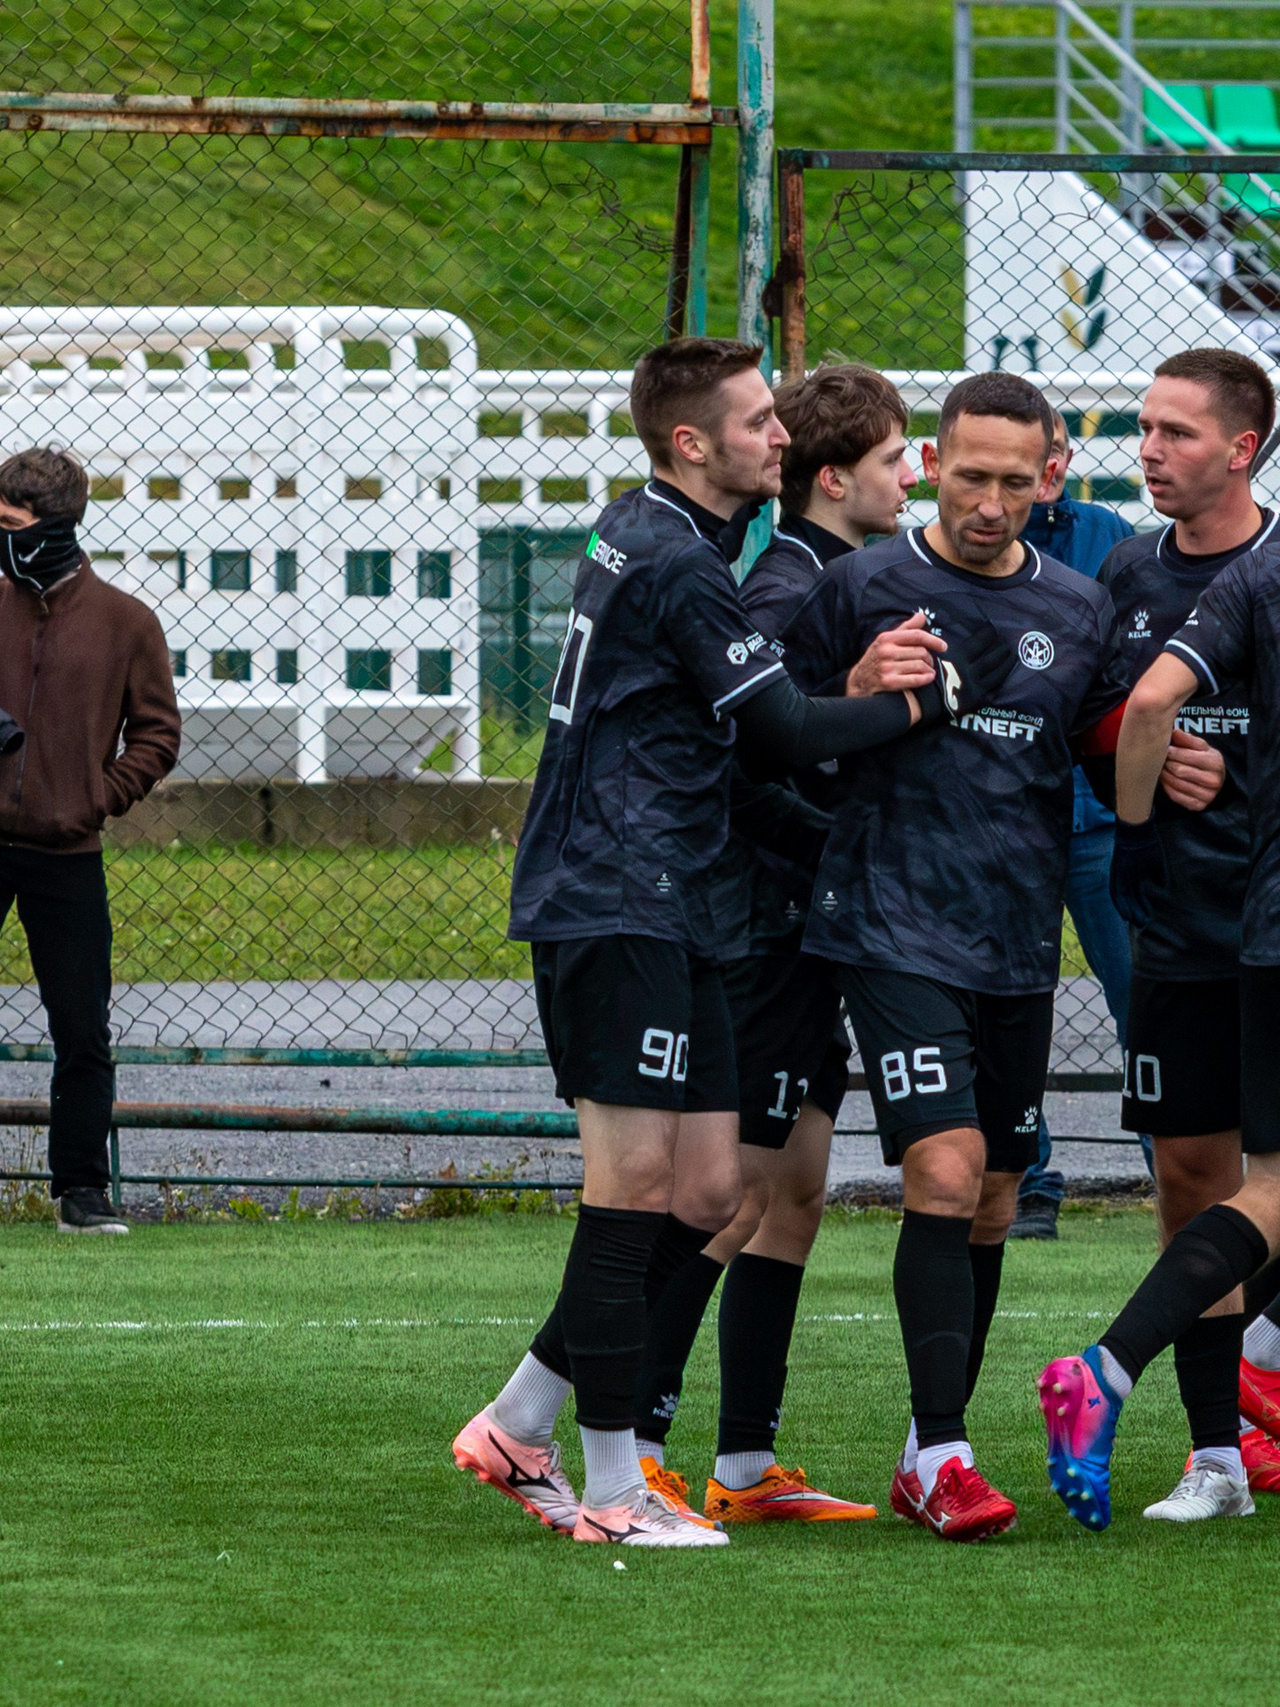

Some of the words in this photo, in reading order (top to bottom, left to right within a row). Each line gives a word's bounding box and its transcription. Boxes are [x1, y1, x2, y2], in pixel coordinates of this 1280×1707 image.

[1127, 629, 1152, 639] KELME
[638, 1028, 689, 1082] 90
[880, 1046, 947, 1101] 85
